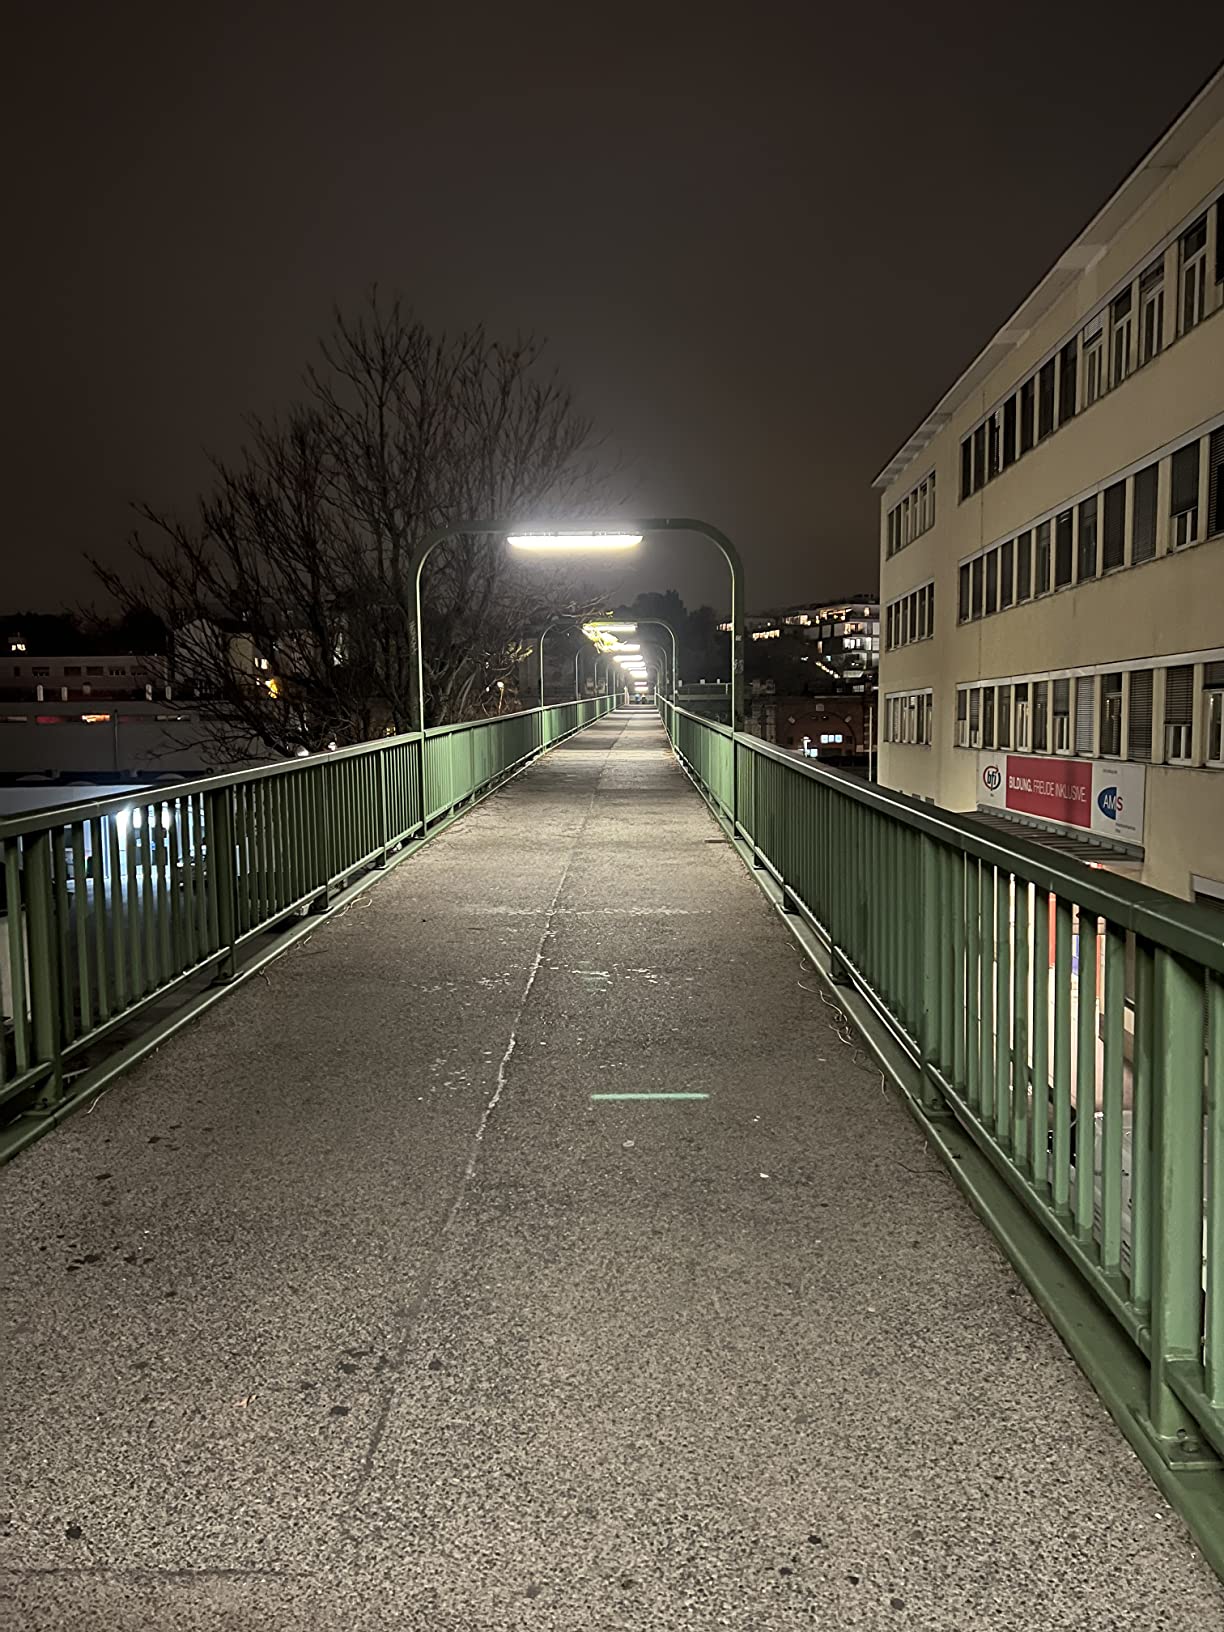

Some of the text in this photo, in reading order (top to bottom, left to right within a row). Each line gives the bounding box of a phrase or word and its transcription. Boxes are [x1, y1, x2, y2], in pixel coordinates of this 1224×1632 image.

[986, 770, 998, 791] bfi
[1008, 775, 1032, 792] BILDUNG.
[1033, 779, 1055, 797] FREUDE
[1103, 794, 1123, 812] AMS
